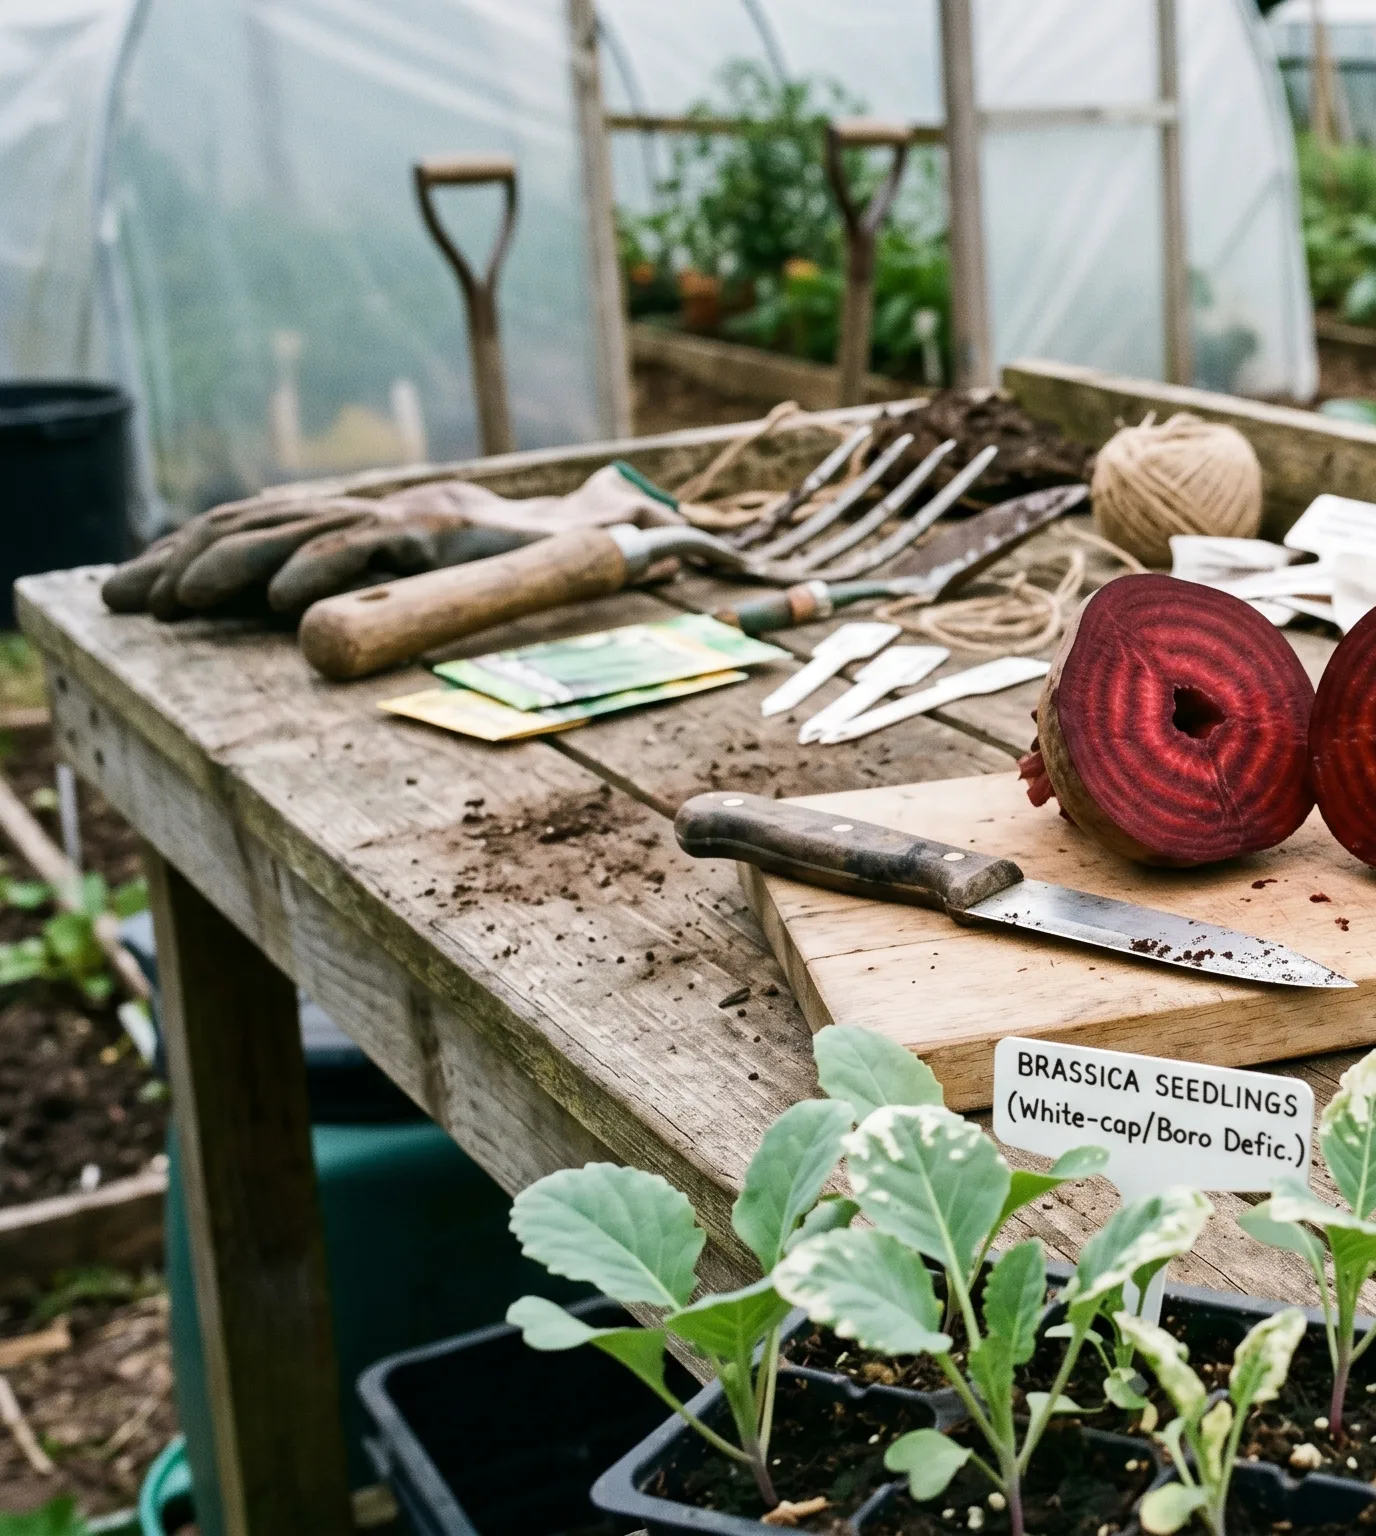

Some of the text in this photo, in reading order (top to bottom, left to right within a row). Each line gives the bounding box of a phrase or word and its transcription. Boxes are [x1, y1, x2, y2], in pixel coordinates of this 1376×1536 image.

[1018, 1051, 1298, 1118] BRASSICA SEEDLINGS
[1007, 1090, 1305, 1168] (White-cap/Boro Defic.)
